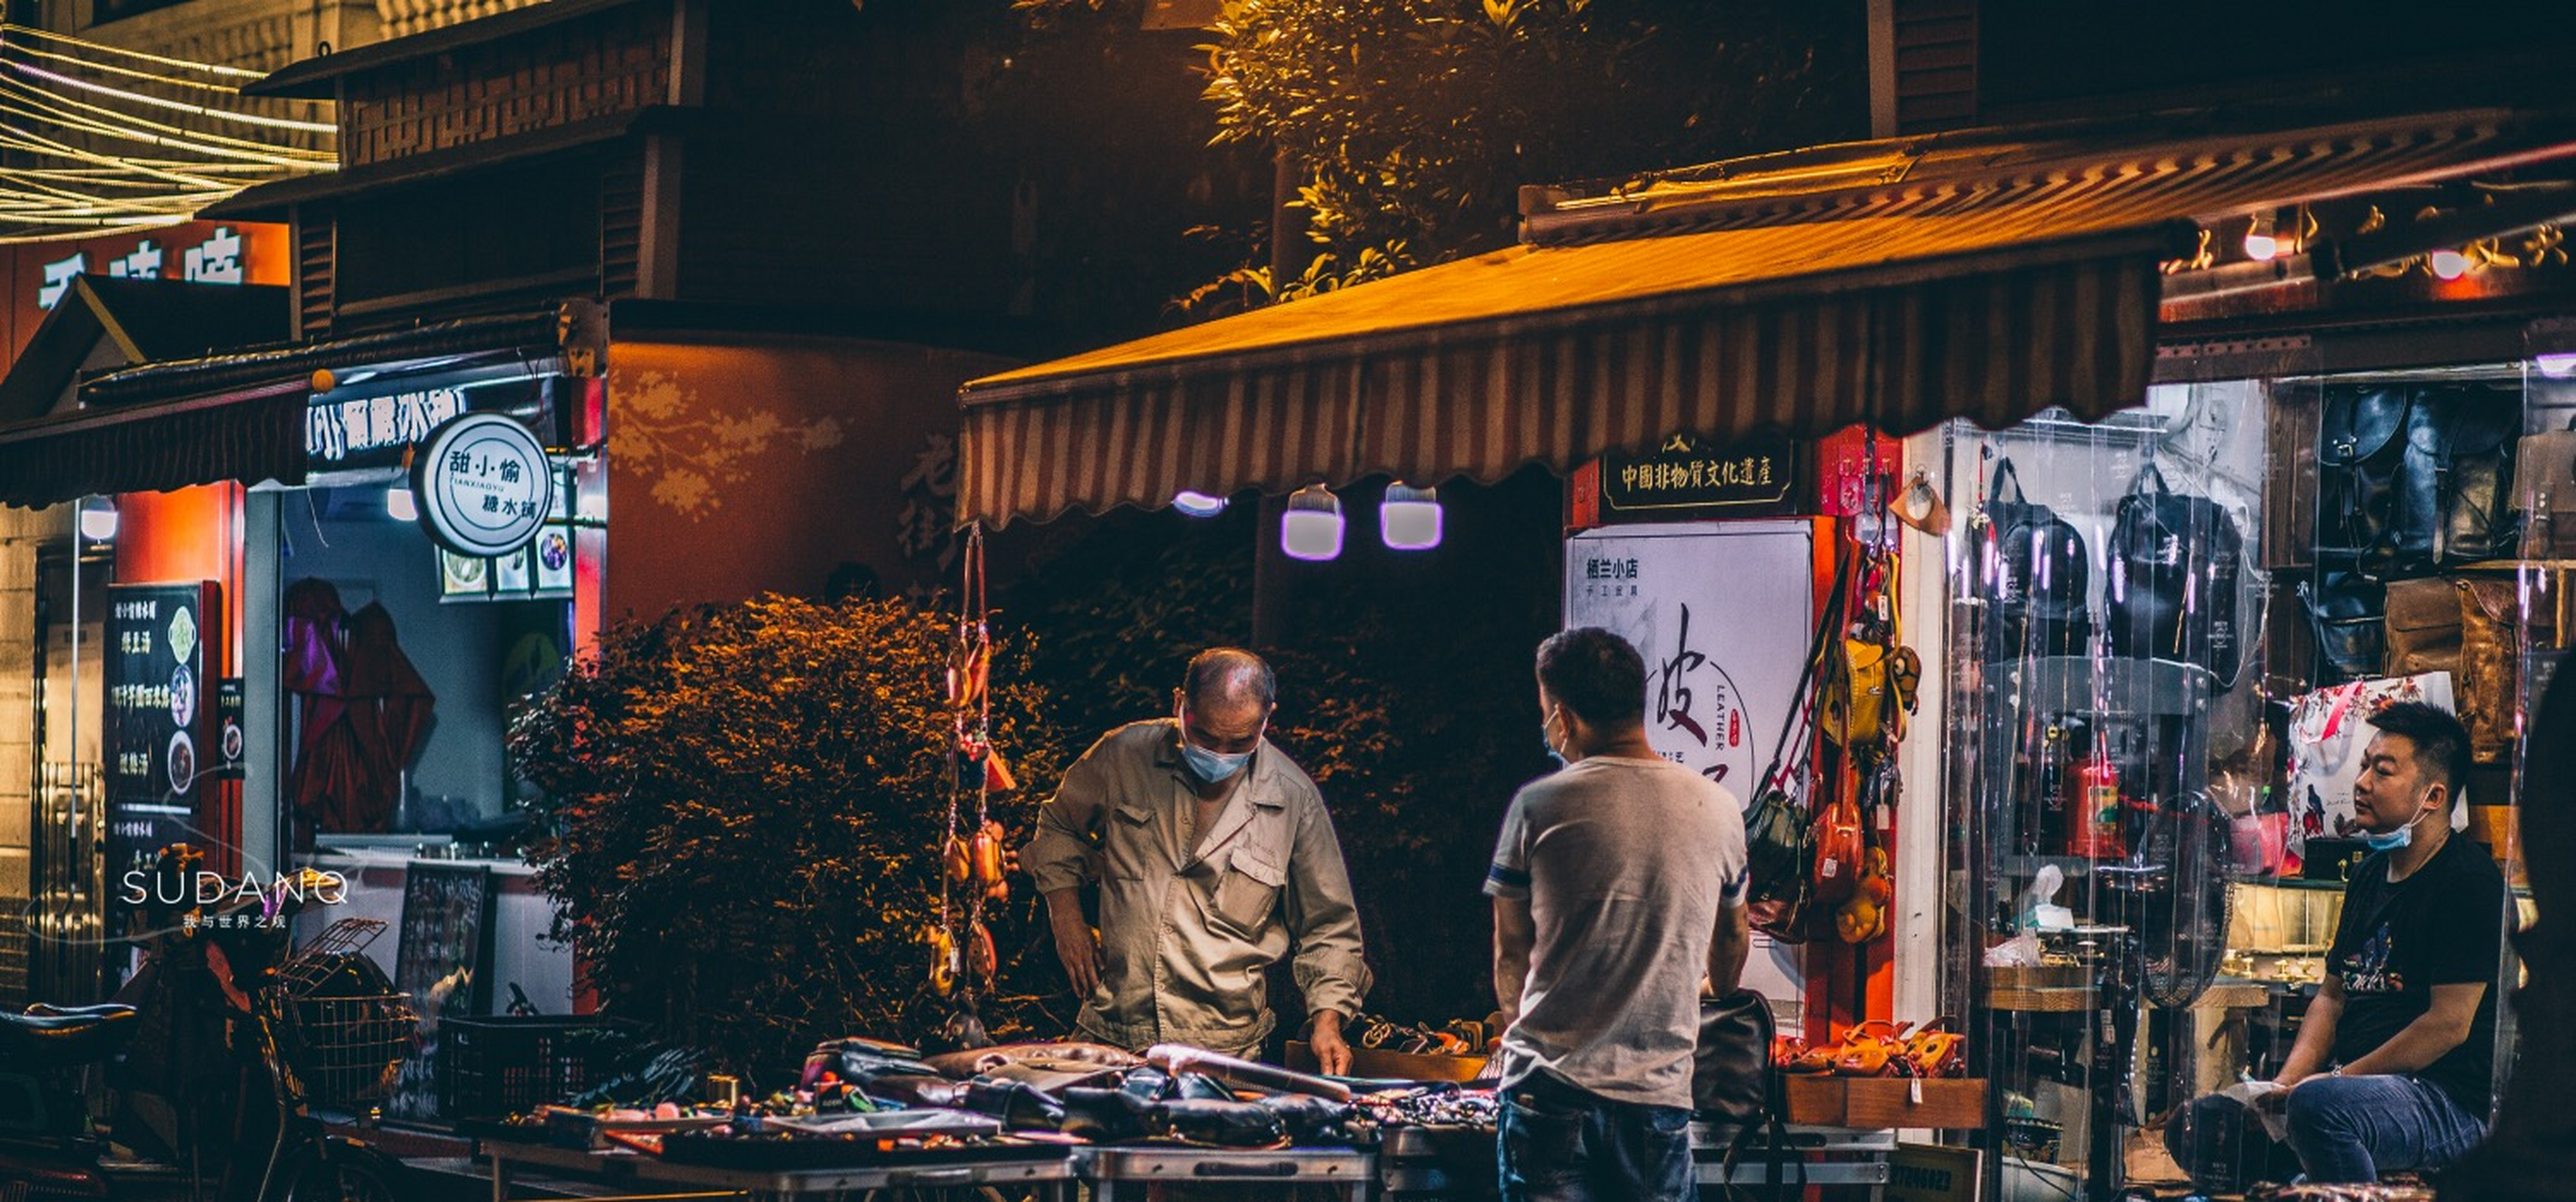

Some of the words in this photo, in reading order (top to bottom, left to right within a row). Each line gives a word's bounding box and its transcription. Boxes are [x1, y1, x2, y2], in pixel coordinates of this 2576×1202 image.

[449, 450, 521, 484] 甜小愉
[1621, 455, 1773, 493] 中國非物質文化遺產
[1586, 558, 1638, 580] 栖兰小店
[1715, 685, 1726, 751] LEATHER
